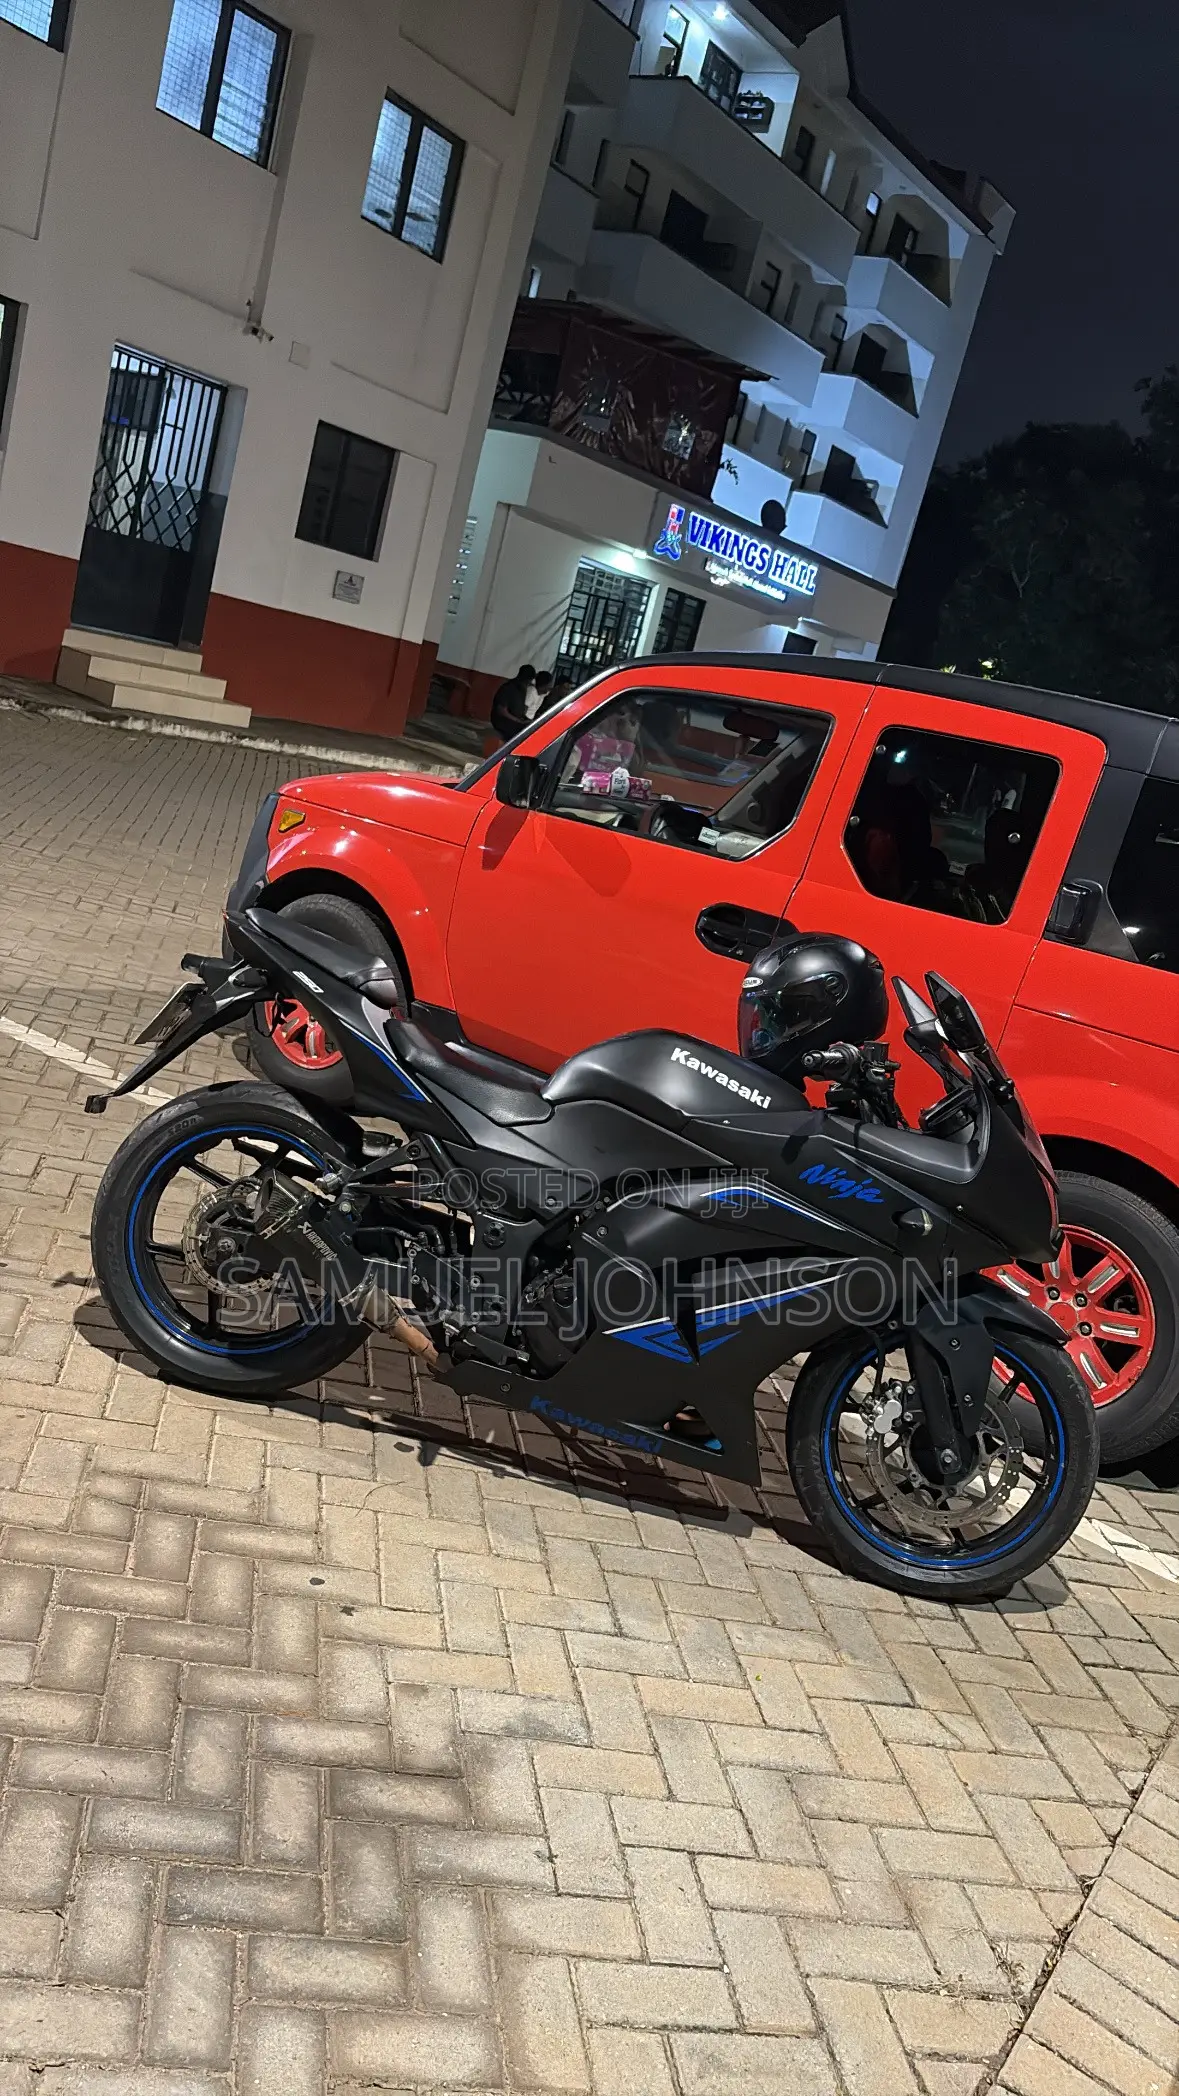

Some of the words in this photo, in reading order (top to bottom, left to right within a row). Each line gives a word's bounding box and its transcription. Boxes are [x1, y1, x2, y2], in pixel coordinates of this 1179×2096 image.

[688, 512, 771, 574] VIKINGS
[768, 550, 818, 596] HALL
[670, 1047, 772, 1109] Kawasaki
[798, 1164, 884, 1204] Ninja
[529, 1395, 663, 1453] Kawasaki
